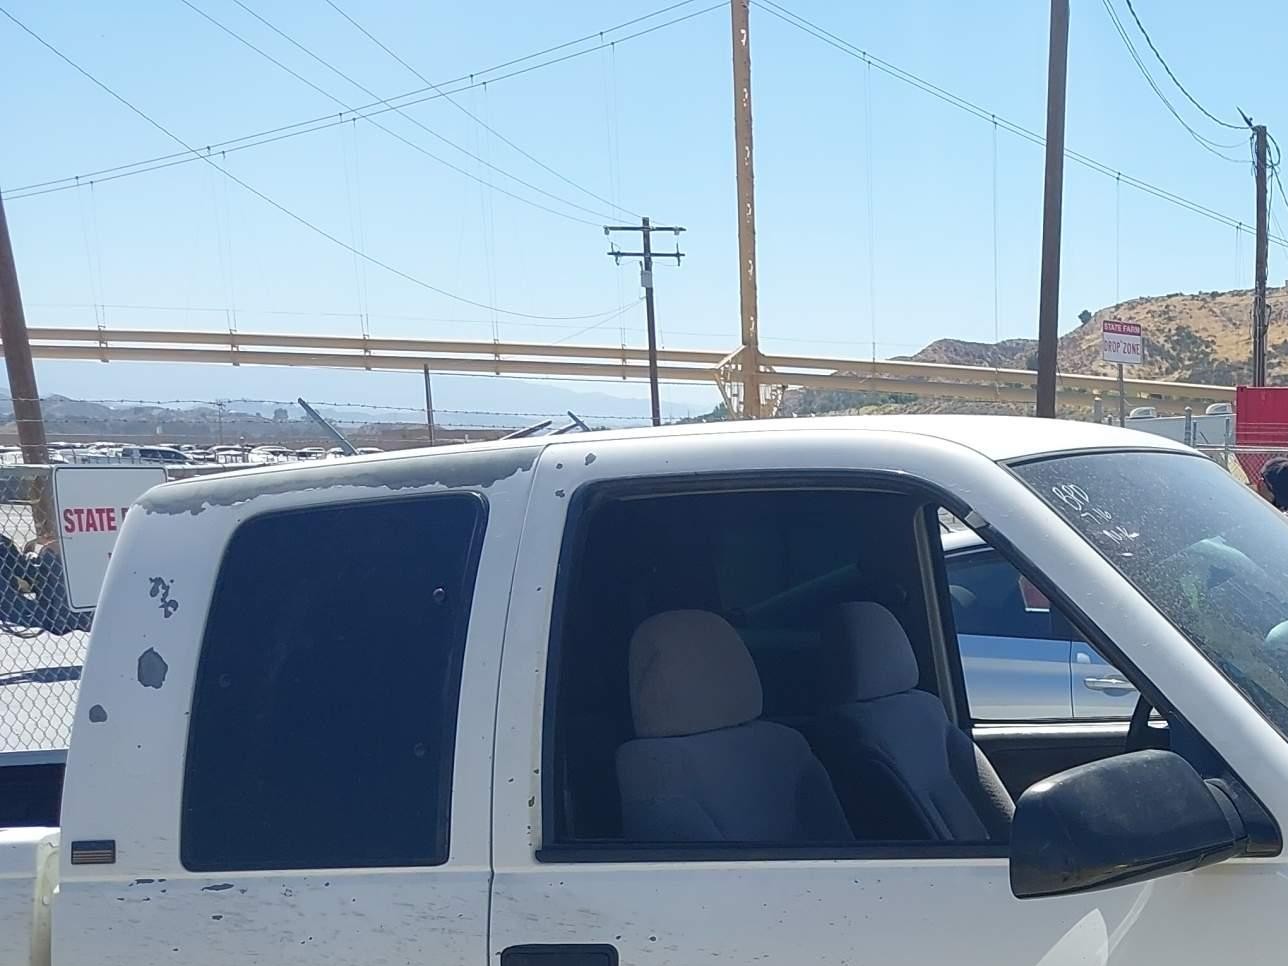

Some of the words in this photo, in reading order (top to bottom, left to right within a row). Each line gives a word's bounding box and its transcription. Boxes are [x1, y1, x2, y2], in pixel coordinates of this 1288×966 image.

[1104, 340, 1121, 352] DROP
[1122, 342, 1141, 355] ZONE
[63, 507, 117, 533] STATE
